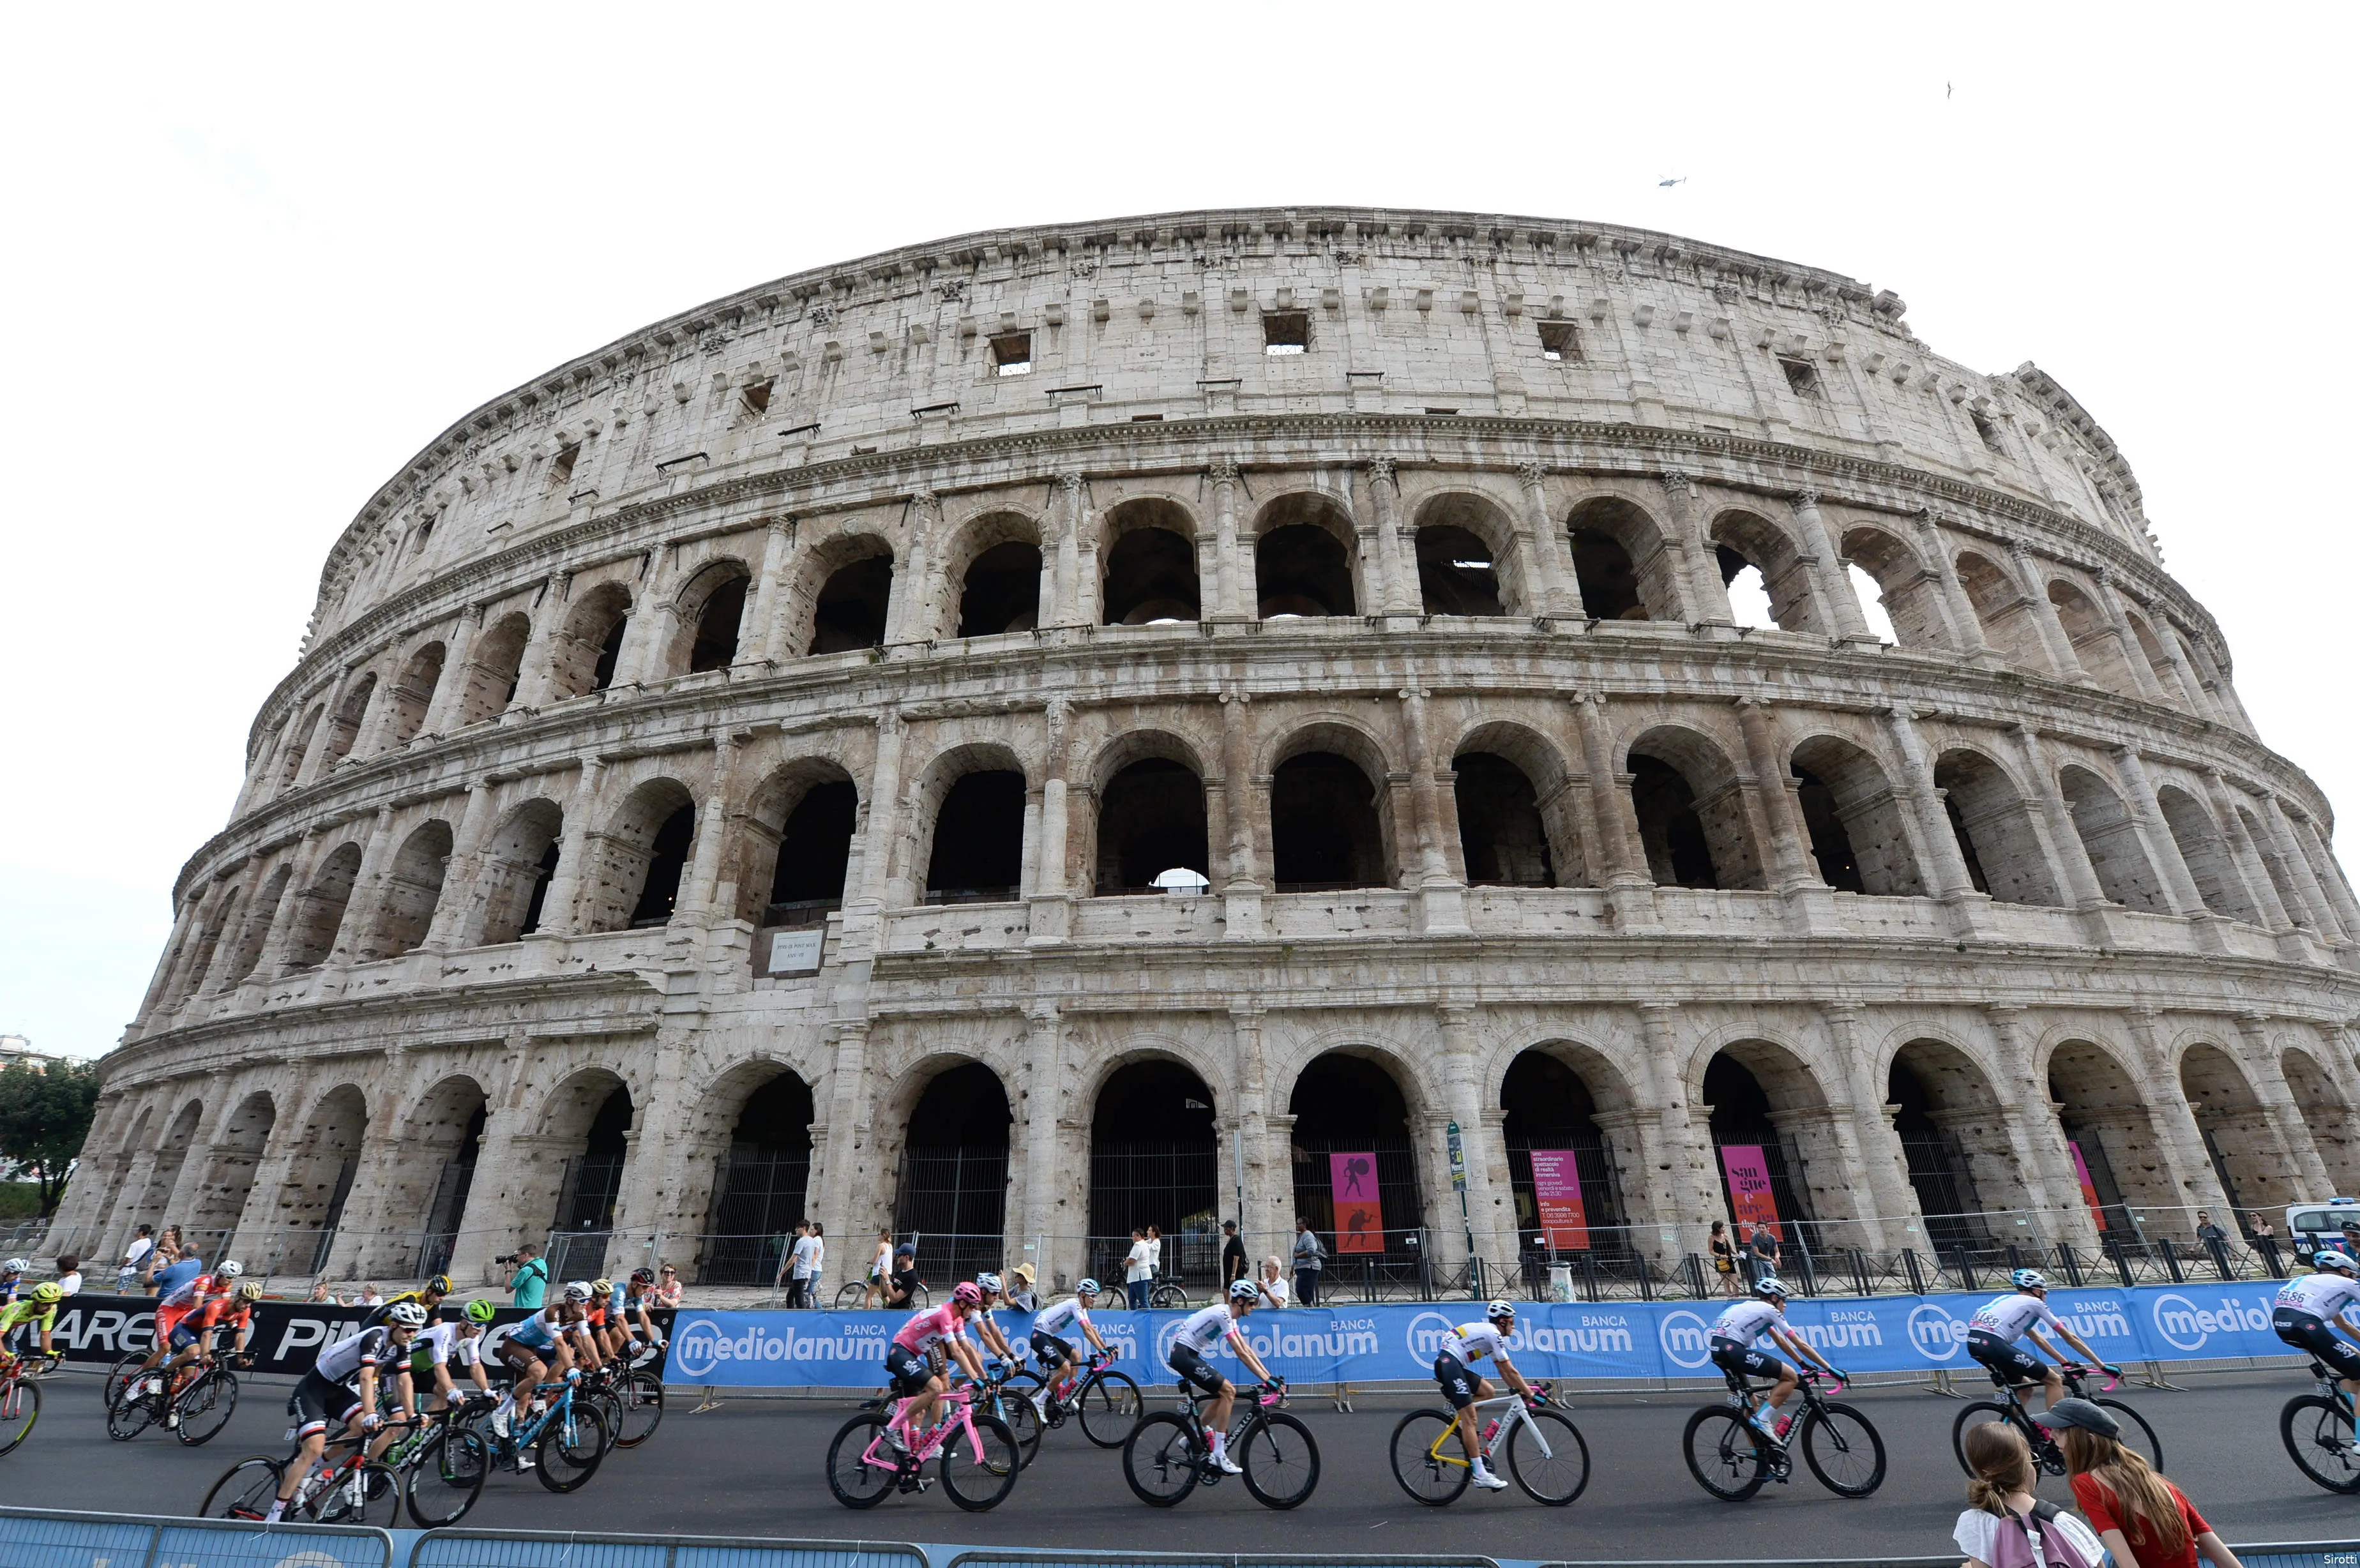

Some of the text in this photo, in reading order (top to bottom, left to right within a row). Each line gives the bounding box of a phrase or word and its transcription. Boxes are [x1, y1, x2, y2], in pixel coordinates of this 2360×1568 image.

[1732, 1167, 1759, 1177] san
[1740, 1177, 1766, 1193] gue
[2074, 1301, 2121, 1314] BANCA
[1581, 1315, 1628, 1327] BANCA
[1831, 1311, 1876, 1323] BANCA
[844, 1325, 886, 1336] BANCA
[1093, 1323, 1135, 1335] BANCA
[1331, 1319, 1376, 1331] BANCA
[684, 1327, 886, 1361] mediolanum
[2333, 1343, 2357, 1359] sky
[1744, 1353, 1764, 1369] sky
[2013, 1353, 2036, 1368] sky
